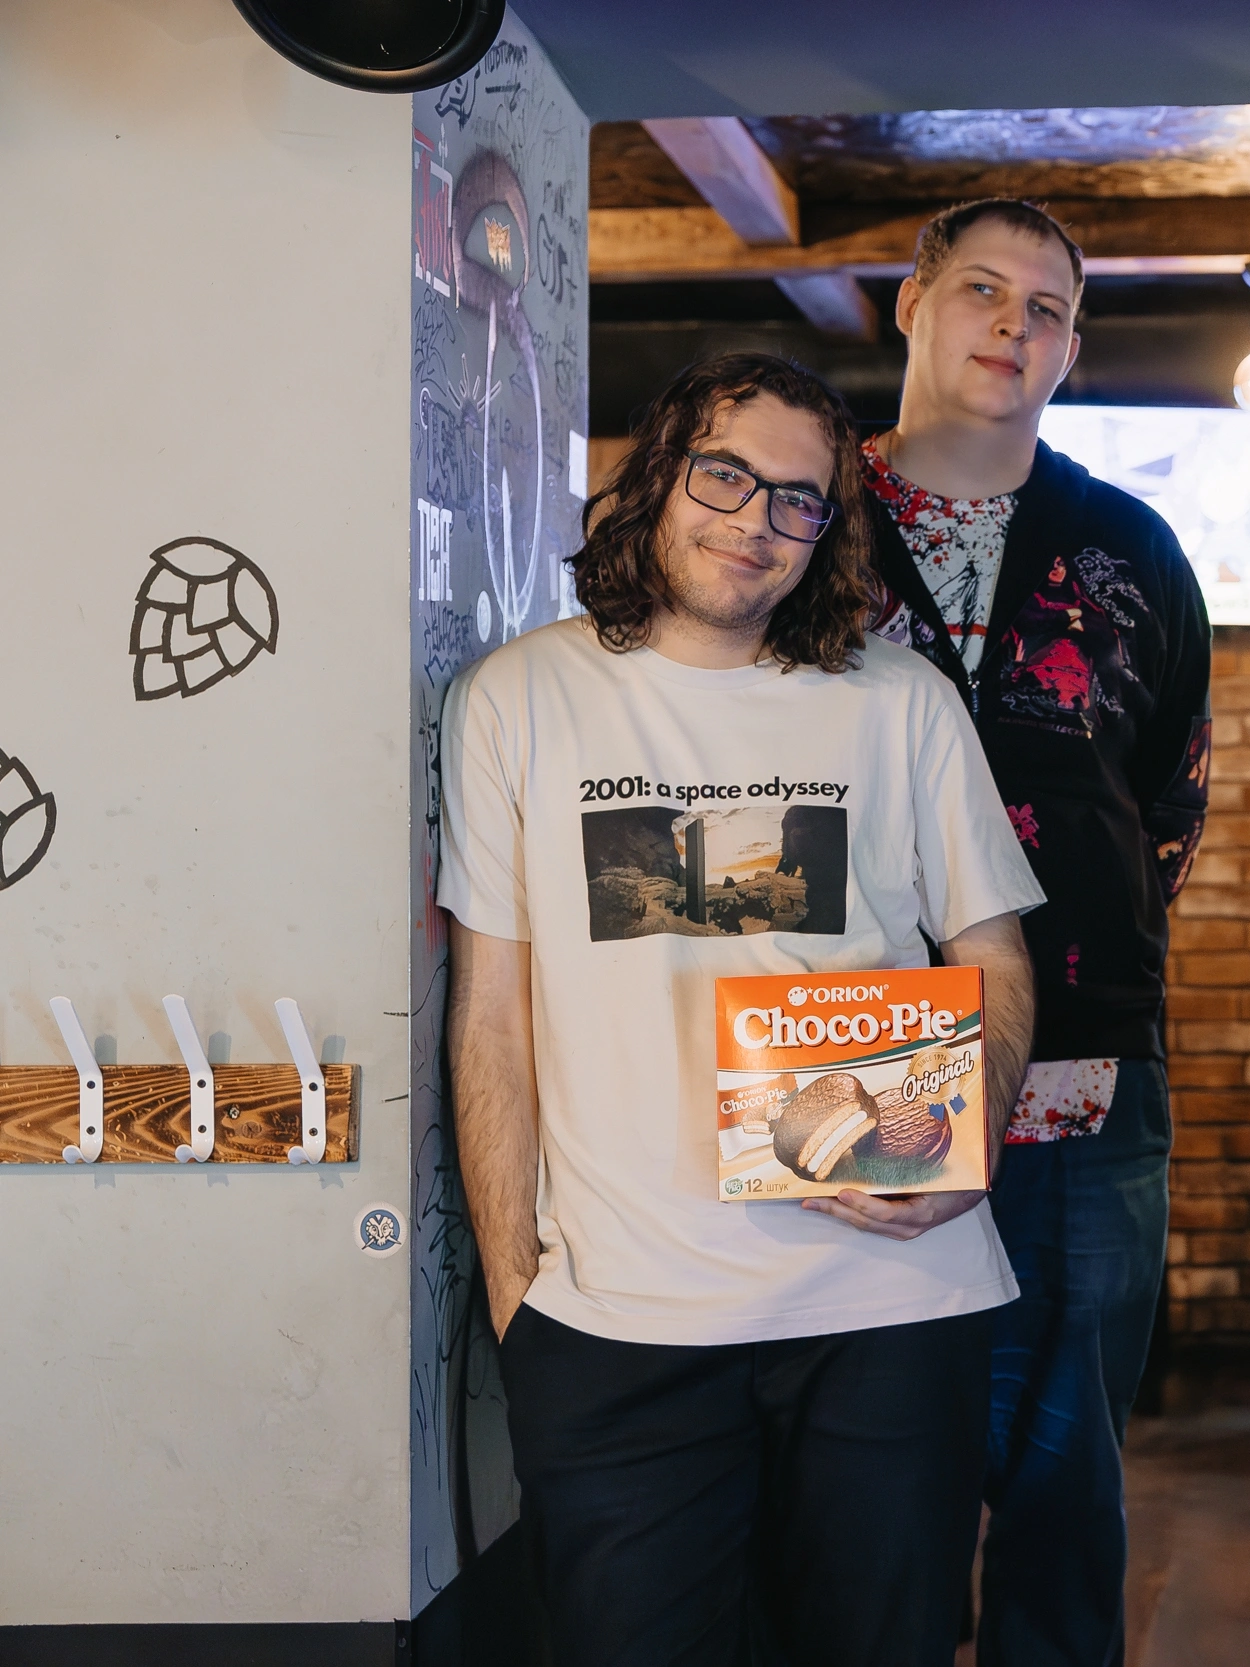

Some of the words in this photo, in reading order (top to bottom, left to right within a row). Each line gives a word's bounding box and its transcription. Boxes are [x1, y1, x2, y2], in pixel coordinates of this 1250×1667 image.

[579, 775, 651, 803] 2001:
[656, 782, 671, 798] a
[675, 783, 742, 807] space
[746, 776, 850, 804] odyssey
[812, 985, 884, 1004] ORION
[902, 1050, 975, 1103] Original
[744, 1178, 763, 1193] 12
